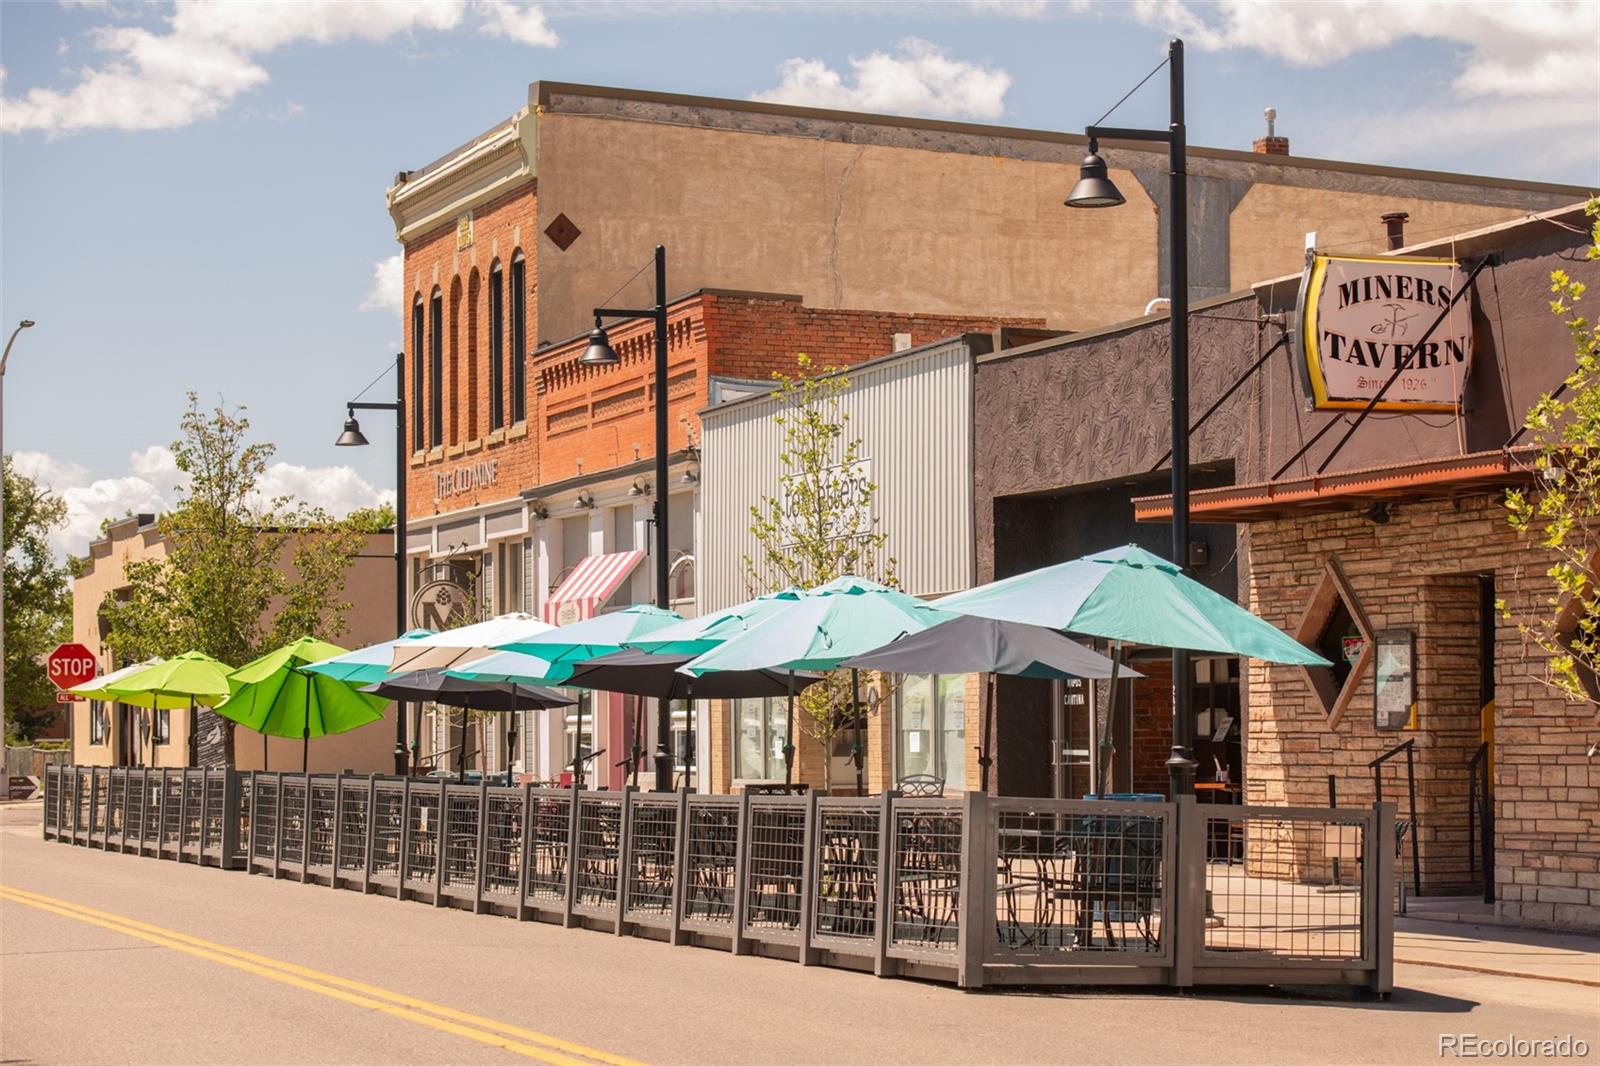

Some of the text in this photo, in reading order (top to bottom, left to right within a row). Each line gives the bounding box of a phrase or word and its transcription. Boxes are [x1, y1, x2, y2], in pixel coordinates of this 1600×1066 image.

[1338, 274, 1453, 310] MINERS
[1324, 331, 1465, 370] TAVERN
[1357, 376, 1388, 390] Sinc
[434, 472, 452, 498] THE
[473, 460, 498, 489] MINE
[51, 658, 93, 676] STOP
